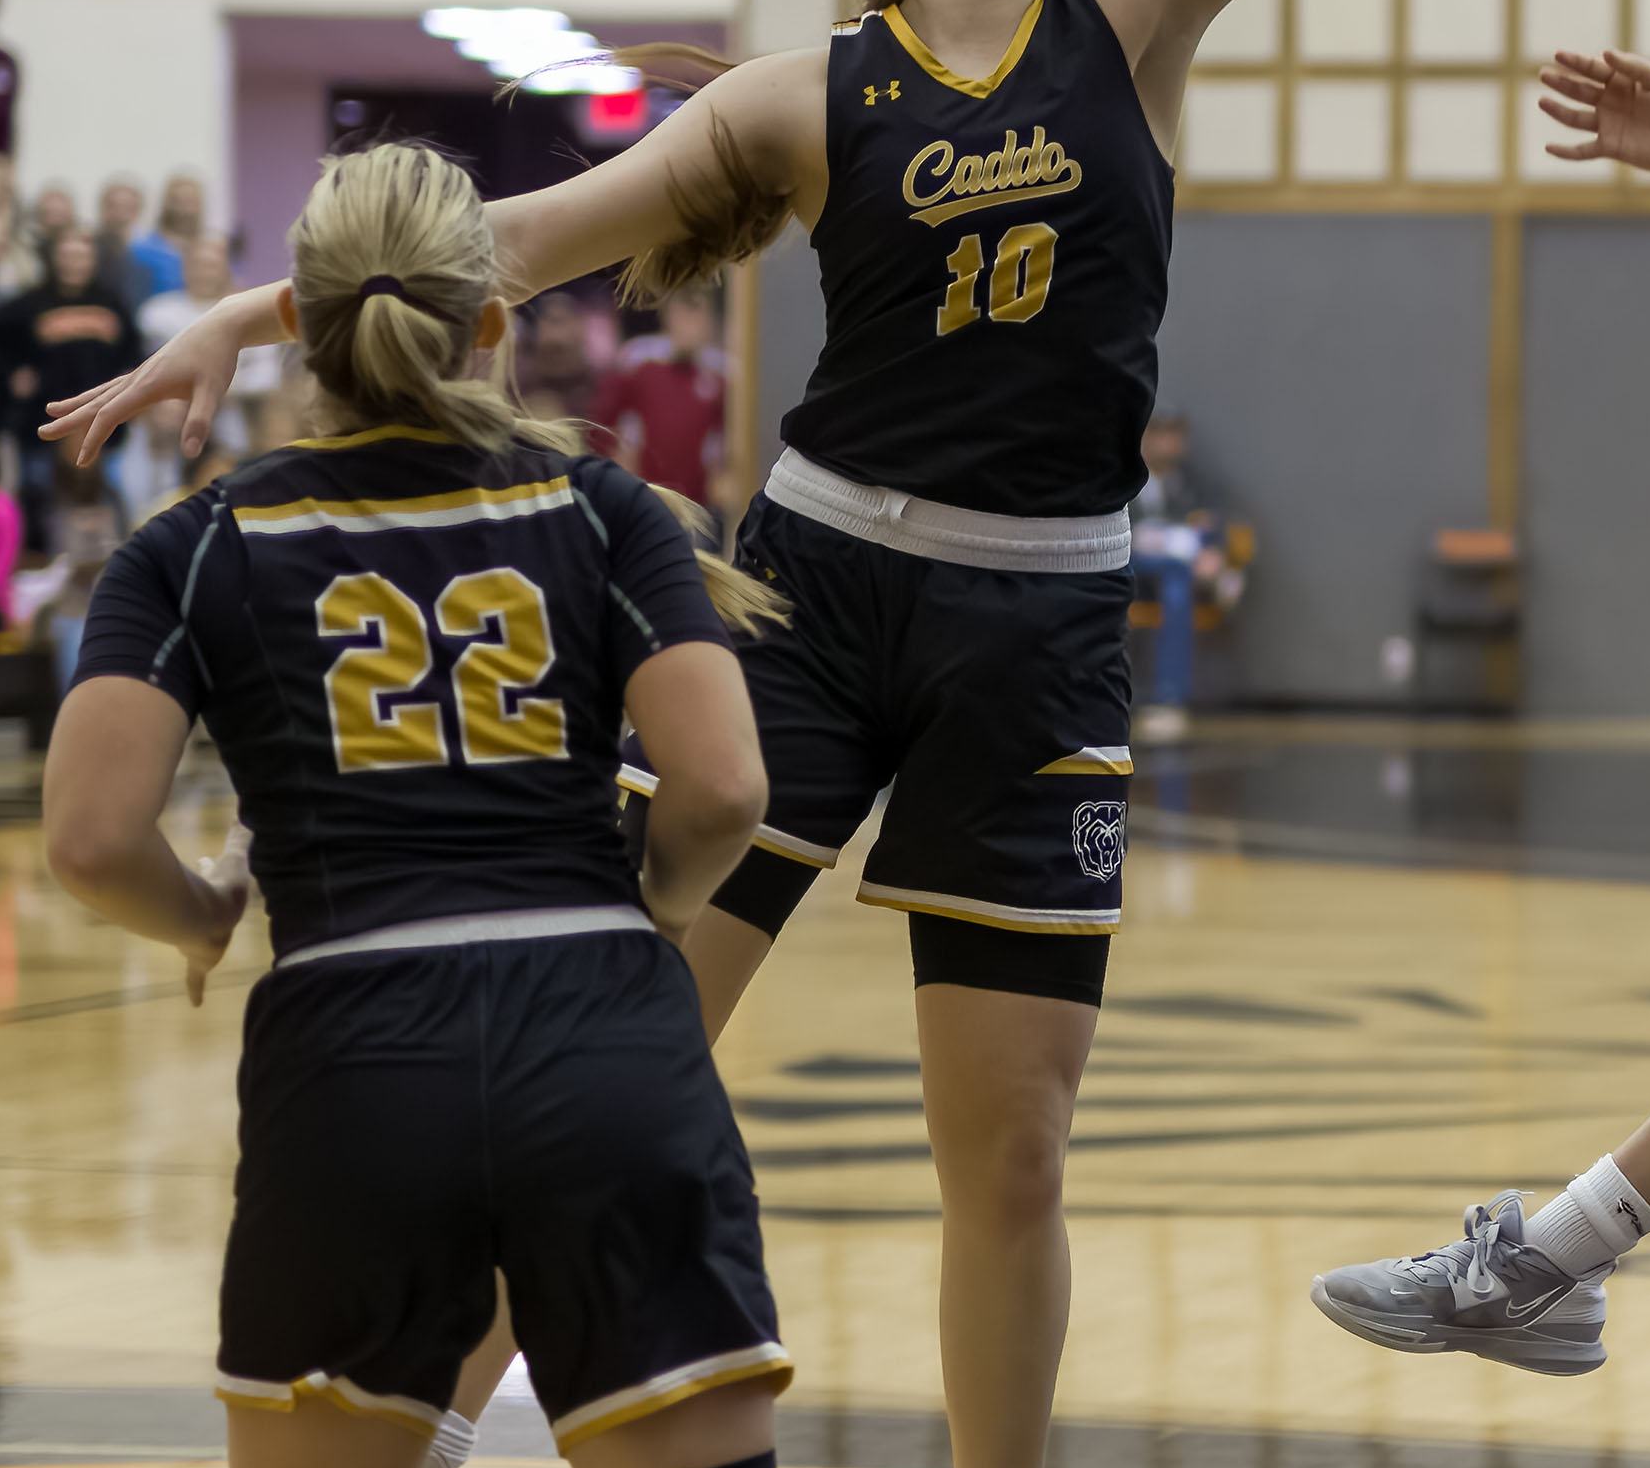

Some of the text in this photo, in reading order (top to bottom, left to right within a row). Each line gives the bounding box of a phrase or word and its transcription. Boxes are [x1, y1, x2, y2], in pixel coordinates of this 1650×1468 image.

[902, 125, 1083, 208] Caddo
[936, 222, 1059, 337] 10
[315, 566, 570, 773] 22
